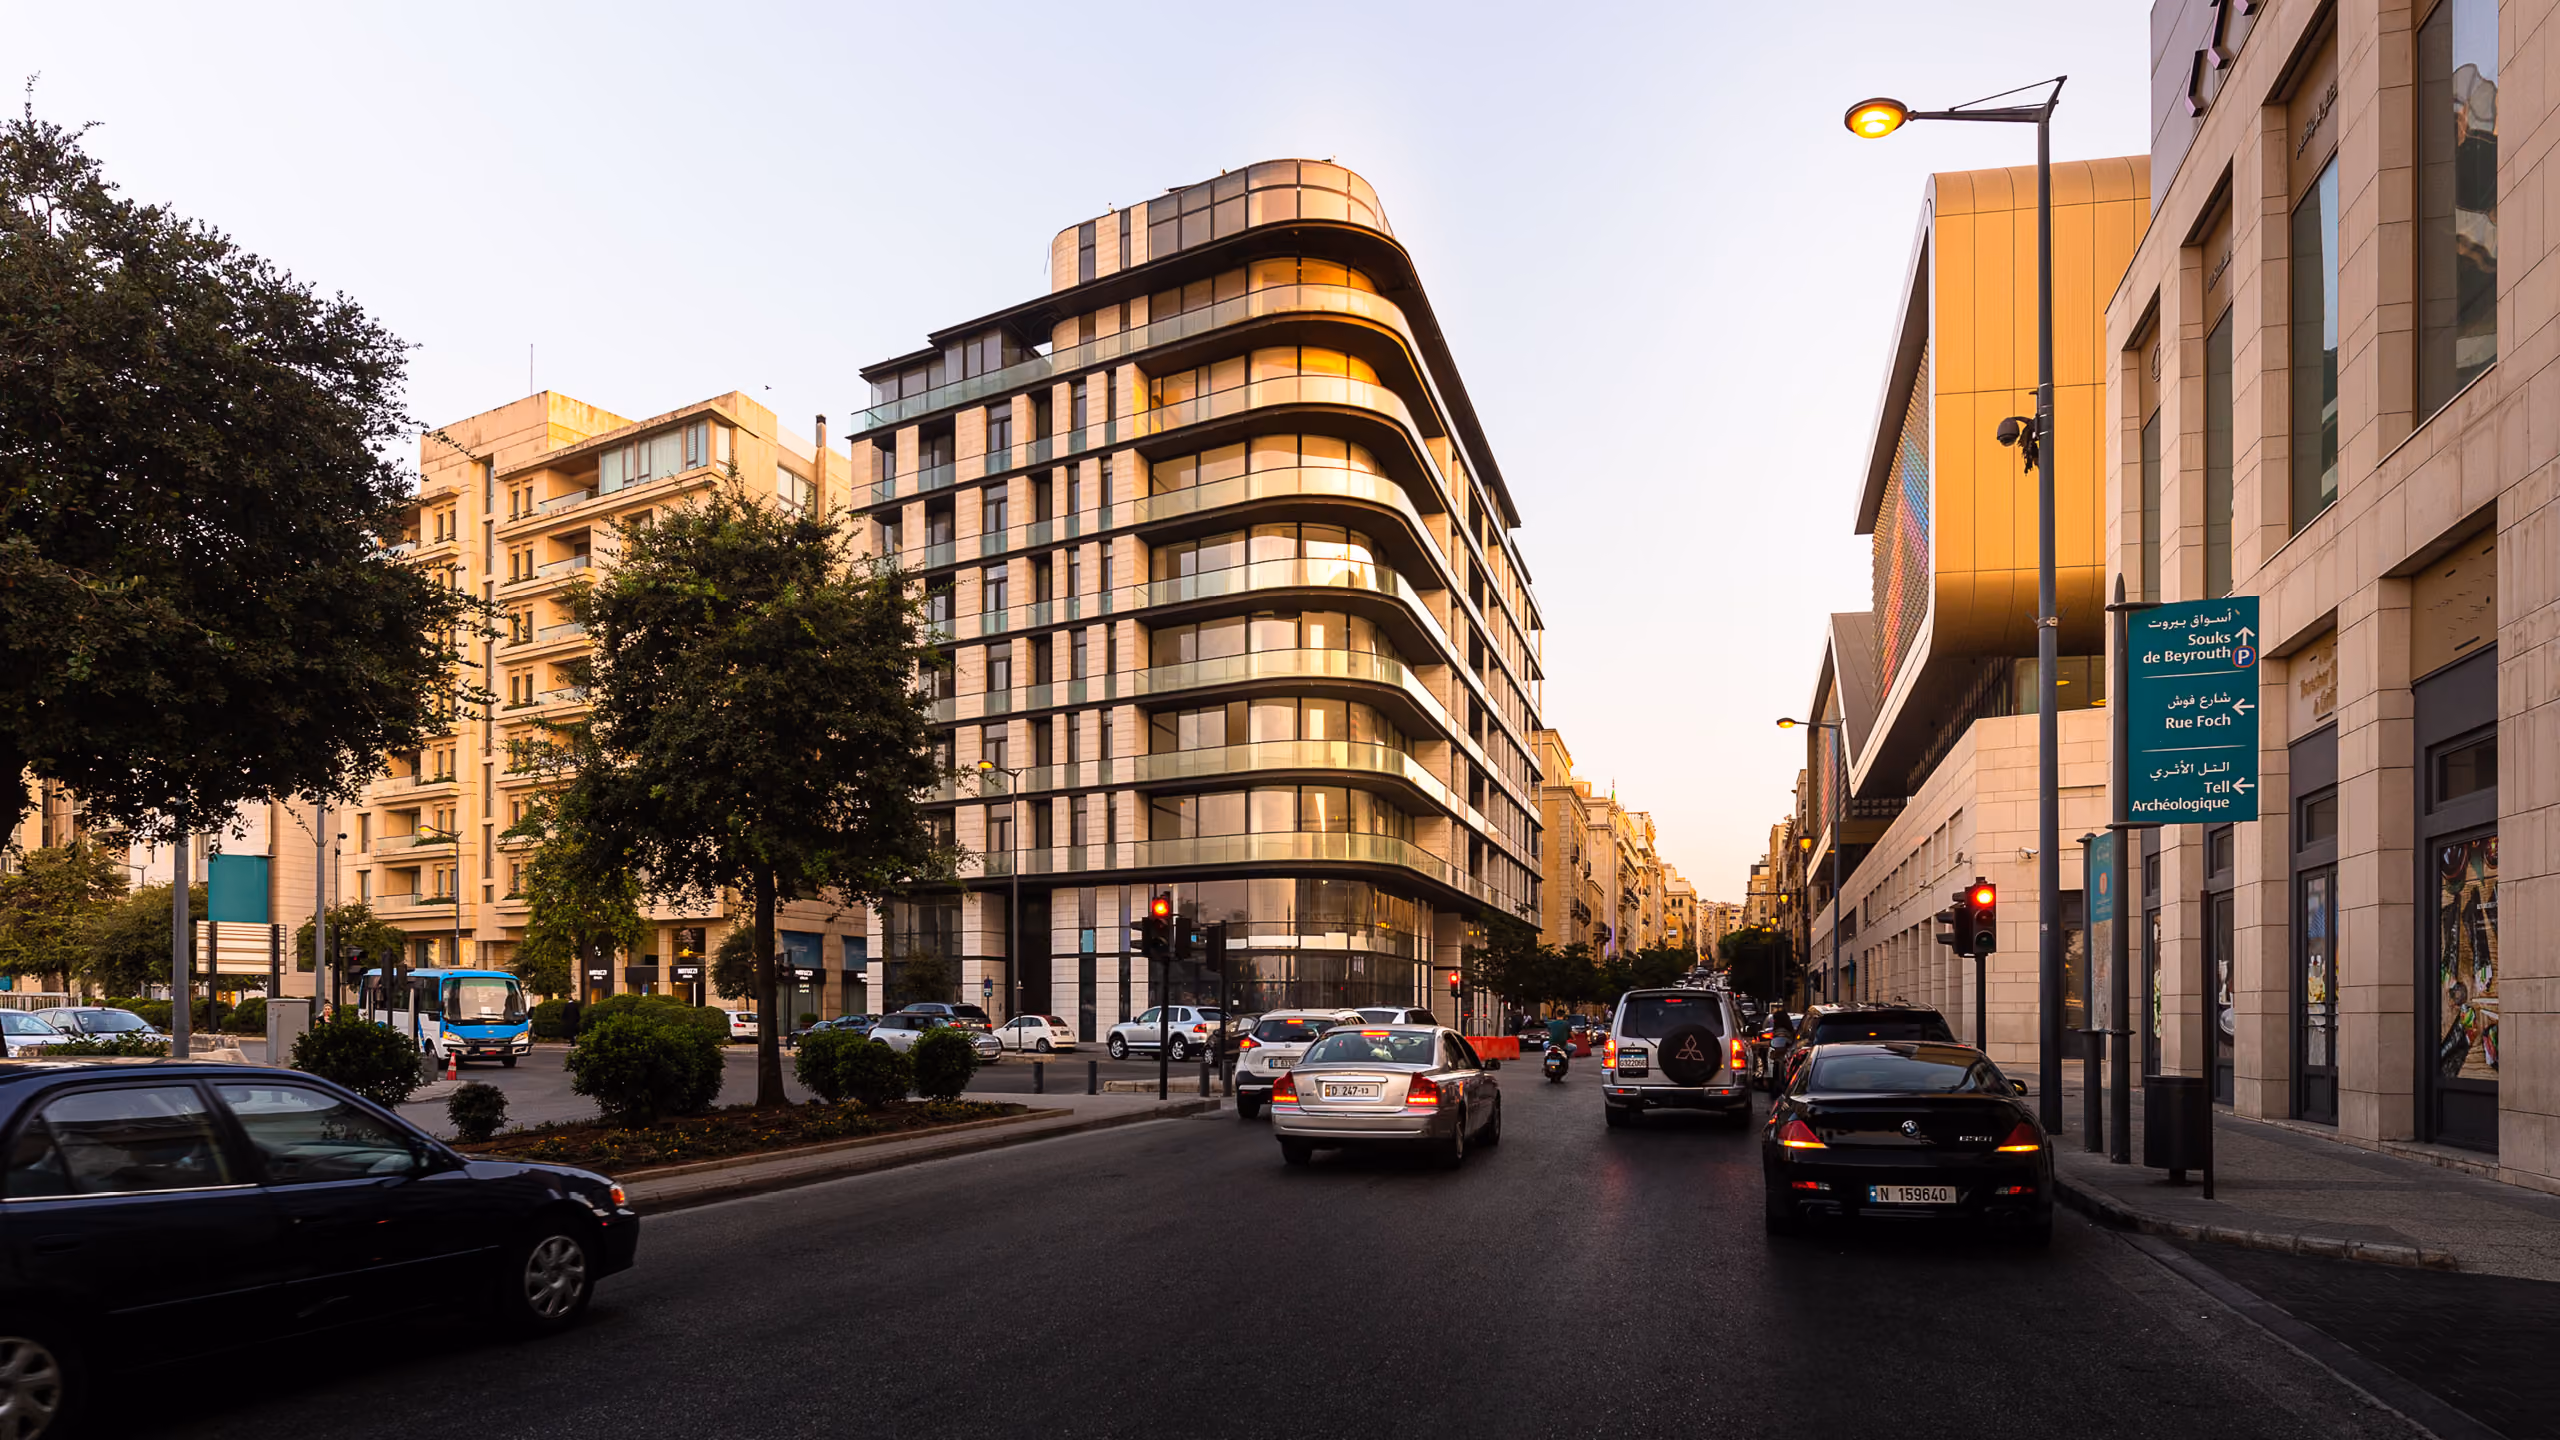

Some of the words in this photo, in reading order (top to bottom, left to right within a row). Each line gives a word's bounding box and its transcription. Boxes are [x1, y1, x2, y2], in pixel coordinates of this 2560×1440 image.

[2148, 617, 2187, 630] بيروت
[2190, 608, 2231, 629] أسواق
[2188, 631, 2231, 646] Souks
[2143, 651, 2161, 664] de
[2164, 646, 2231, 664] Beyrouth
[2237, 649, 2250, 665] P
[2167, 694, 2196, 710] فوش
[2199, 691, 2231, 710] شارع
[2165, 716, 2193, 729] Rue
[2197, 714, 2231, 728] Foch
[2149, 760, 2194, 780] الأثري
[2198, 761, 2230, 777] التل
[2204, 780, 2230, 794] Tell
[2132, 797, 2230, 812] Archéologique
[1331, 1086, 1338, 1096] D
[1880, 1187, 1890, 1201] N
[1898, 1187, 1948, 1202] 159640
